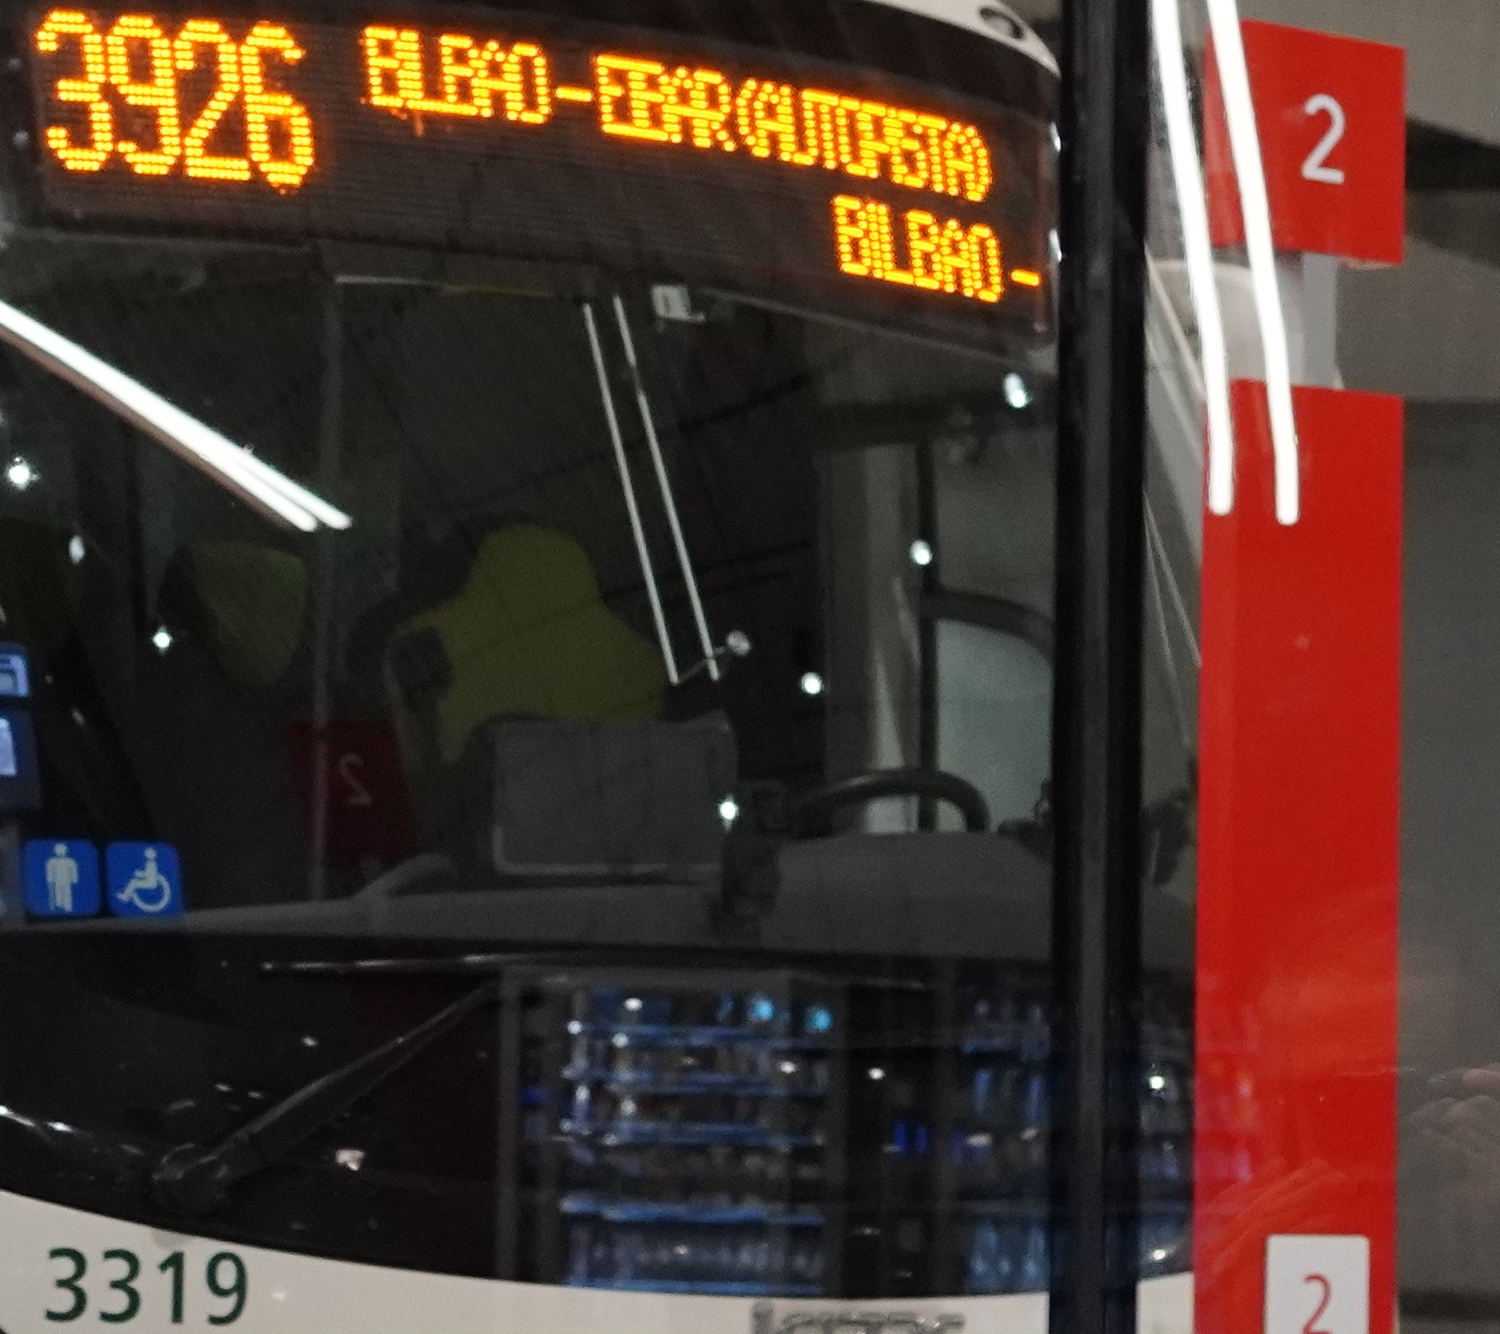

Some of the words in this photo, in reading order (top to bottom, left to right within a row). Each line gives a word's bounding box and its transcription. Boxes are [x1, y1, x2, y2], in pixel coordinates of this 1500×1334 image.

[35, 9, 315, 186] 3926
[1301, 92, 1346, 186] 2
[45, 1246, 248, 1327] 3319
